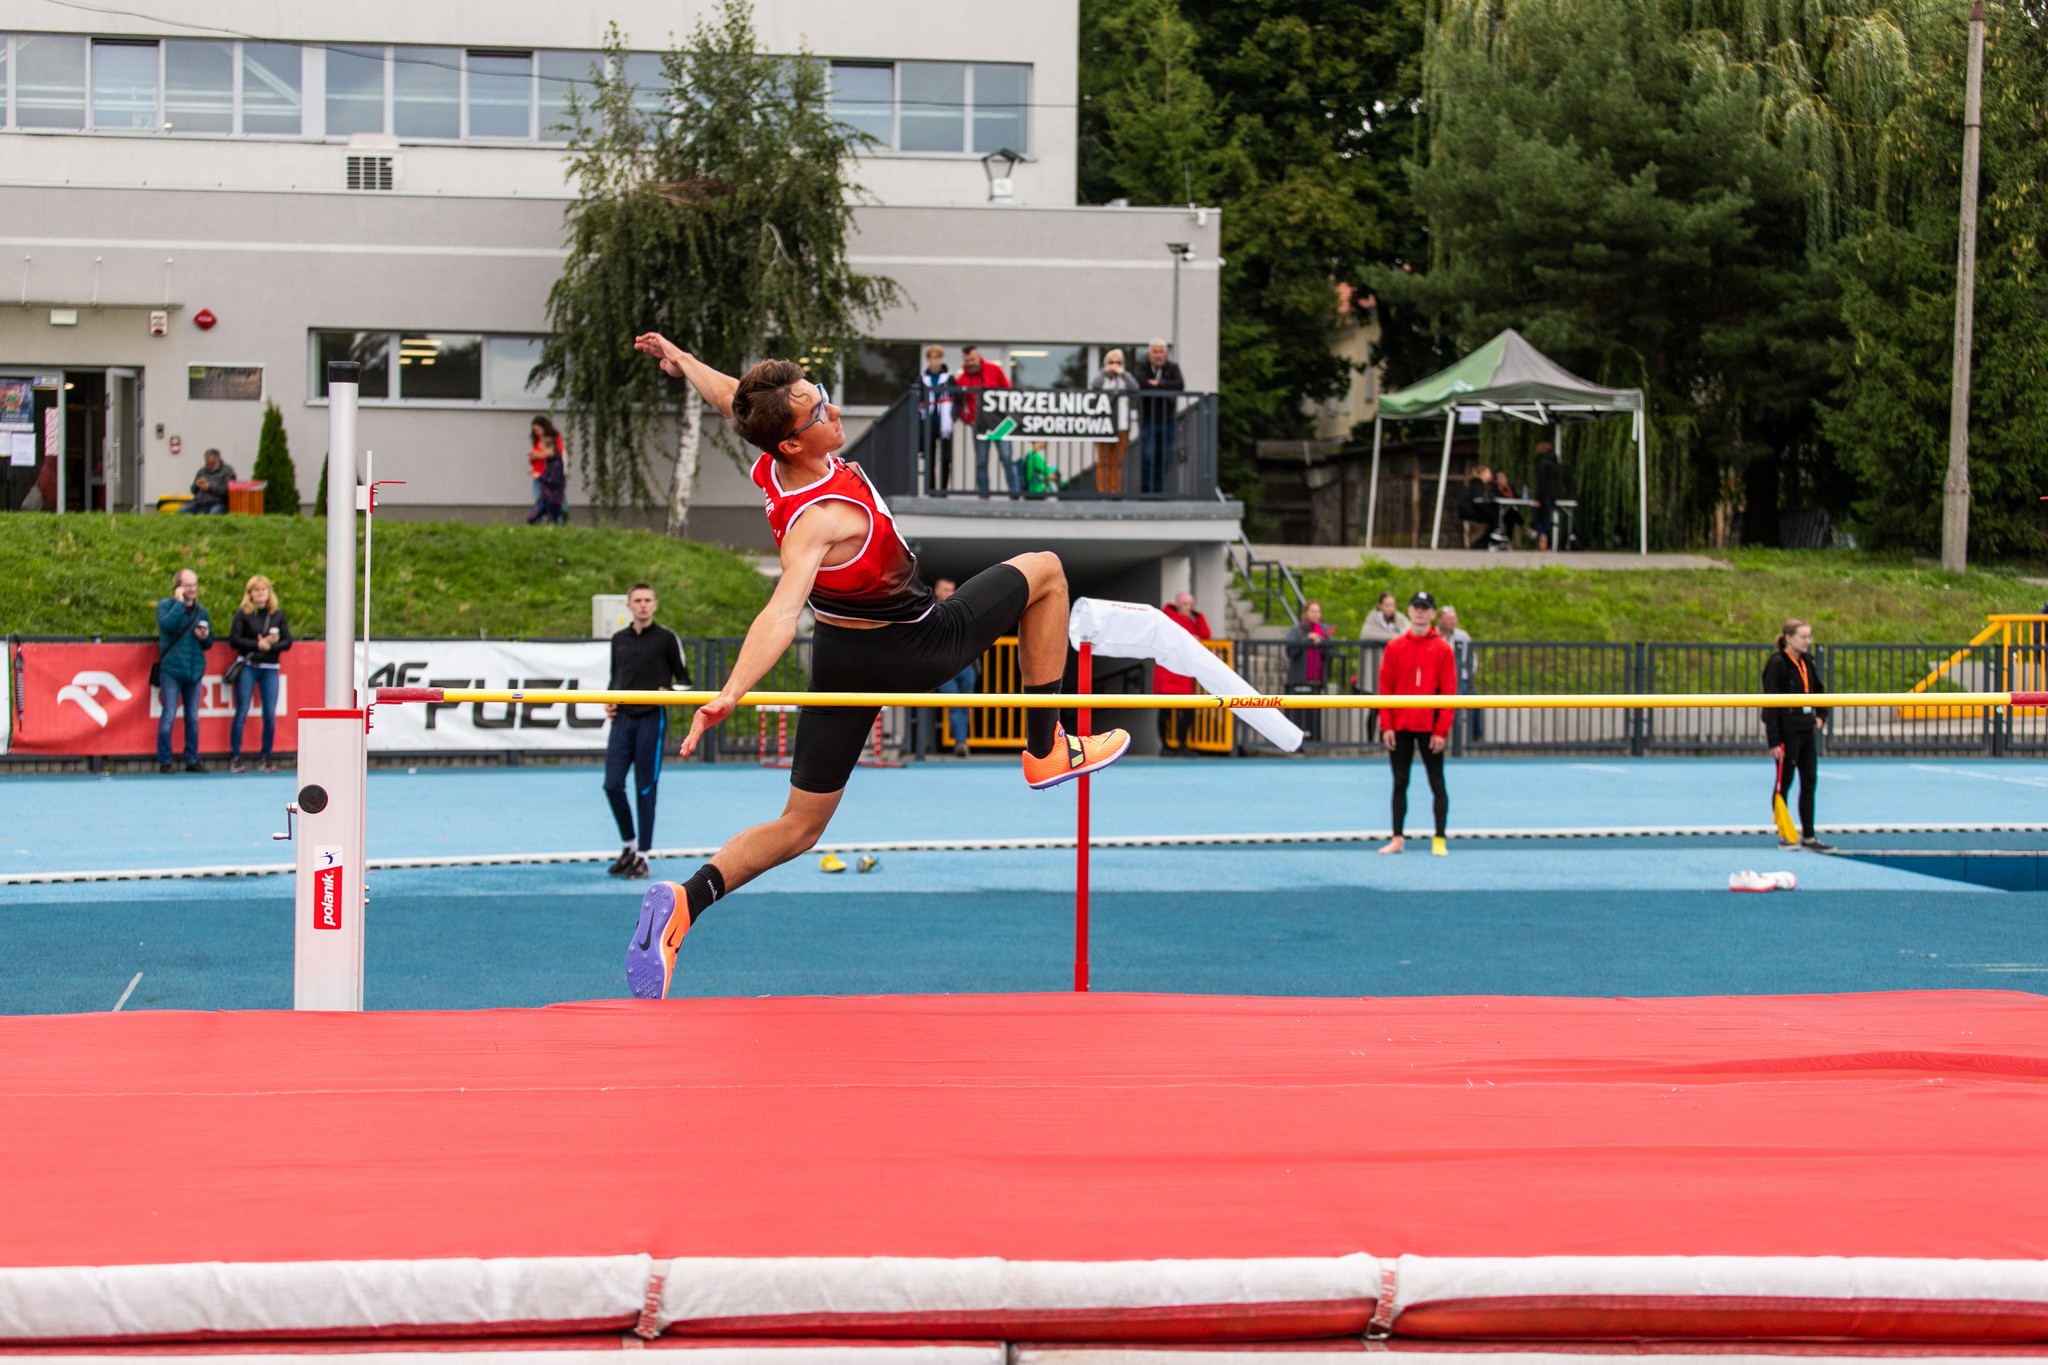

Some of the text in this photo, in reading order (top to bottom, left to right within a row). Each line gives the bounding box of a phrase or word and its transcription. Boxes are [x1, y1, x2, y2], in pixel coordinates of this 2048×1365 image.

[982, 390, 1112, 415] STRZELNICA
[1022, 416, 1114, 434] SPORTOWA
[424, 678, 606, 730] FUEL
[1229, 696, 1283, 708] polanik
[321, 873, 337, 927] polanik
